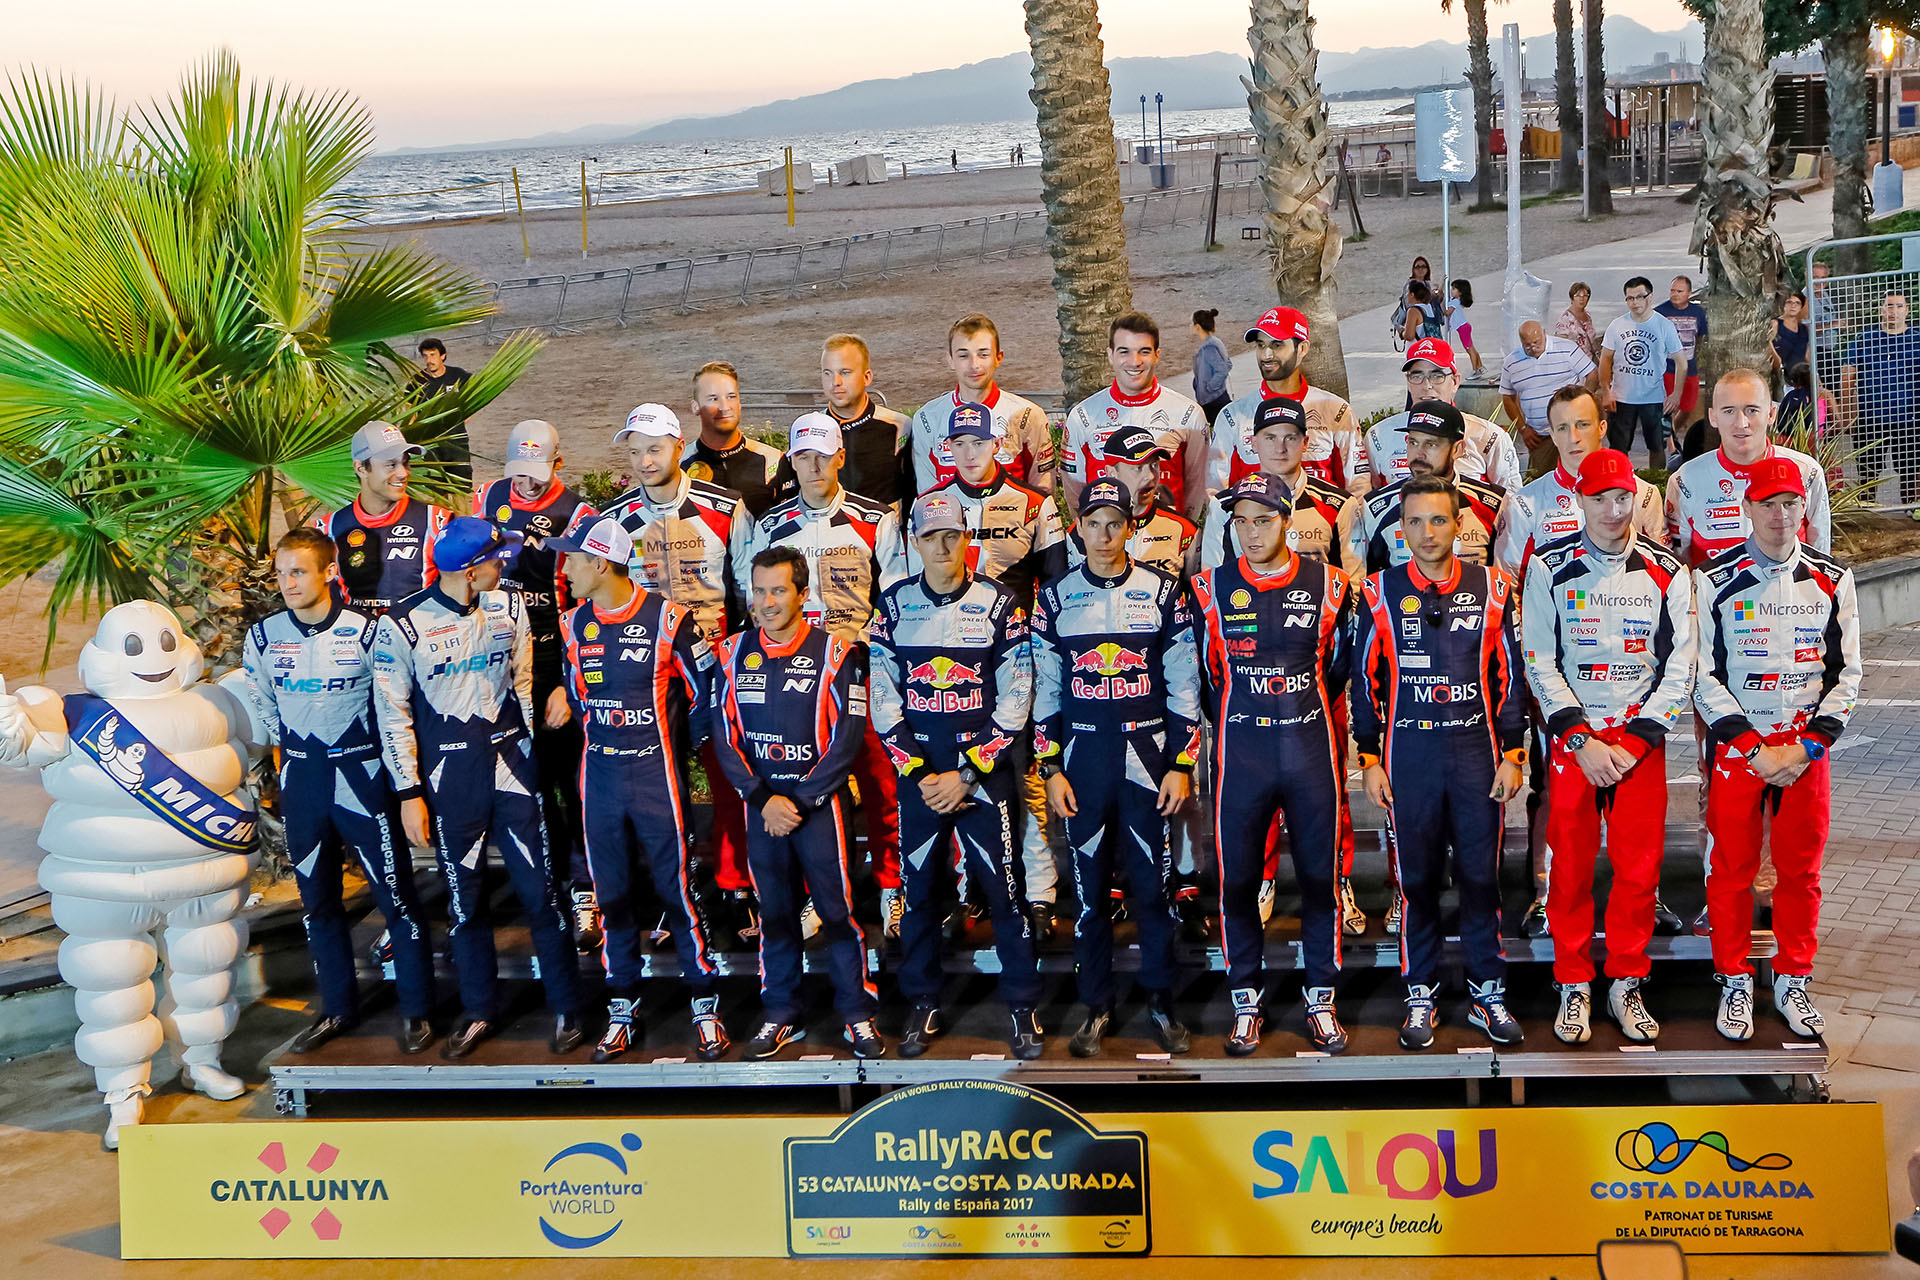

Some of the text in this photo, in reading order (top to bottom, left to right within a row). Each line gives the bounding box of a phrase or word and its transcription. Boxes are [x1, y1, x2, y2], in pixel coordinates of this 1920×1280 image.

[1553, 522, 1577, 530] TOTAL
[647, 536, 706, 552] Microsoft
[1045, 587, 1059, 613] sparco
[1159, 579, 1172, 606] sparco
[1283, 602, 1317, 611] HYUNDAI
[1590, 593, 1653, 608] Microsoft
[1449, 605, 1482, 613] HYUNDAI
[1759, 603, 1825, 616] Microsoft
[1623, 618, 1652, 626] Panasonic
[1570, 627, 1598, 636] DENSO
[1623, 628, 1642, 636] Mobil
[430, 640, 461, 653] DELFI
[1738, 638, 1768, 646] DENSO
[1795, 637, 1813, 645] Mobil
[784, 667, 817, 675] HYUNDAI
[1236, 665, 1285, 676] HYUNDAI
[1578, 670, 1608, 681] GR
[1071, 673, 1151, 700] Red Bull
[1250, 672, 1310, 695] MOBIS
[1401, 675, 1449, 684] HYUNDAI
[1745, 680, 1776, 691] GR
[1781, 683, 1807, 691] Racing
[1414, 683, 1477, 703] MOBIS
[1529, 667, 1553, 708] Microsoft
[588, 699, 622, 708] HYUNDAI
[907, 688, 983, 713] Red Bull
[596, 708, 654, 728] MOBIS
[745, 731, 783, 743] HYUNDAI
[439, 741, 467, 751] sparco
[754, 744, 813, 761] MOBIS
[997, 800, 1013, 865] EcoBoost
[1721, 1019, 1746, 1030] OMP
[893, 1081, 1030, 1102] FIA WORLD RALLY CHAMPIONSHIP
[875, 1128, 1054, 1170] RallyRACC
[1252, 1128, 1498, 1200] SALOU
[211, 1179, 390, 1202] CATALUNYA
[520, 1180, 643, 1196] PortAventura
[798, 1176, 819, 1193] 53
[1017, 1173, 1136, 1191] DAURADA
[1590, 1180, 1815, 1200] COSTA DAURADA
[550, 1199, 615, 1214] WORLD
[899, 1197, 1034, 1214] Rally de España 2017
[806, 1225, 851, 1240] SALOU
[1311, 1213, 1443, 1240] europe's beach
[1005, 1231, 1051, 1239] CATALUNYA
